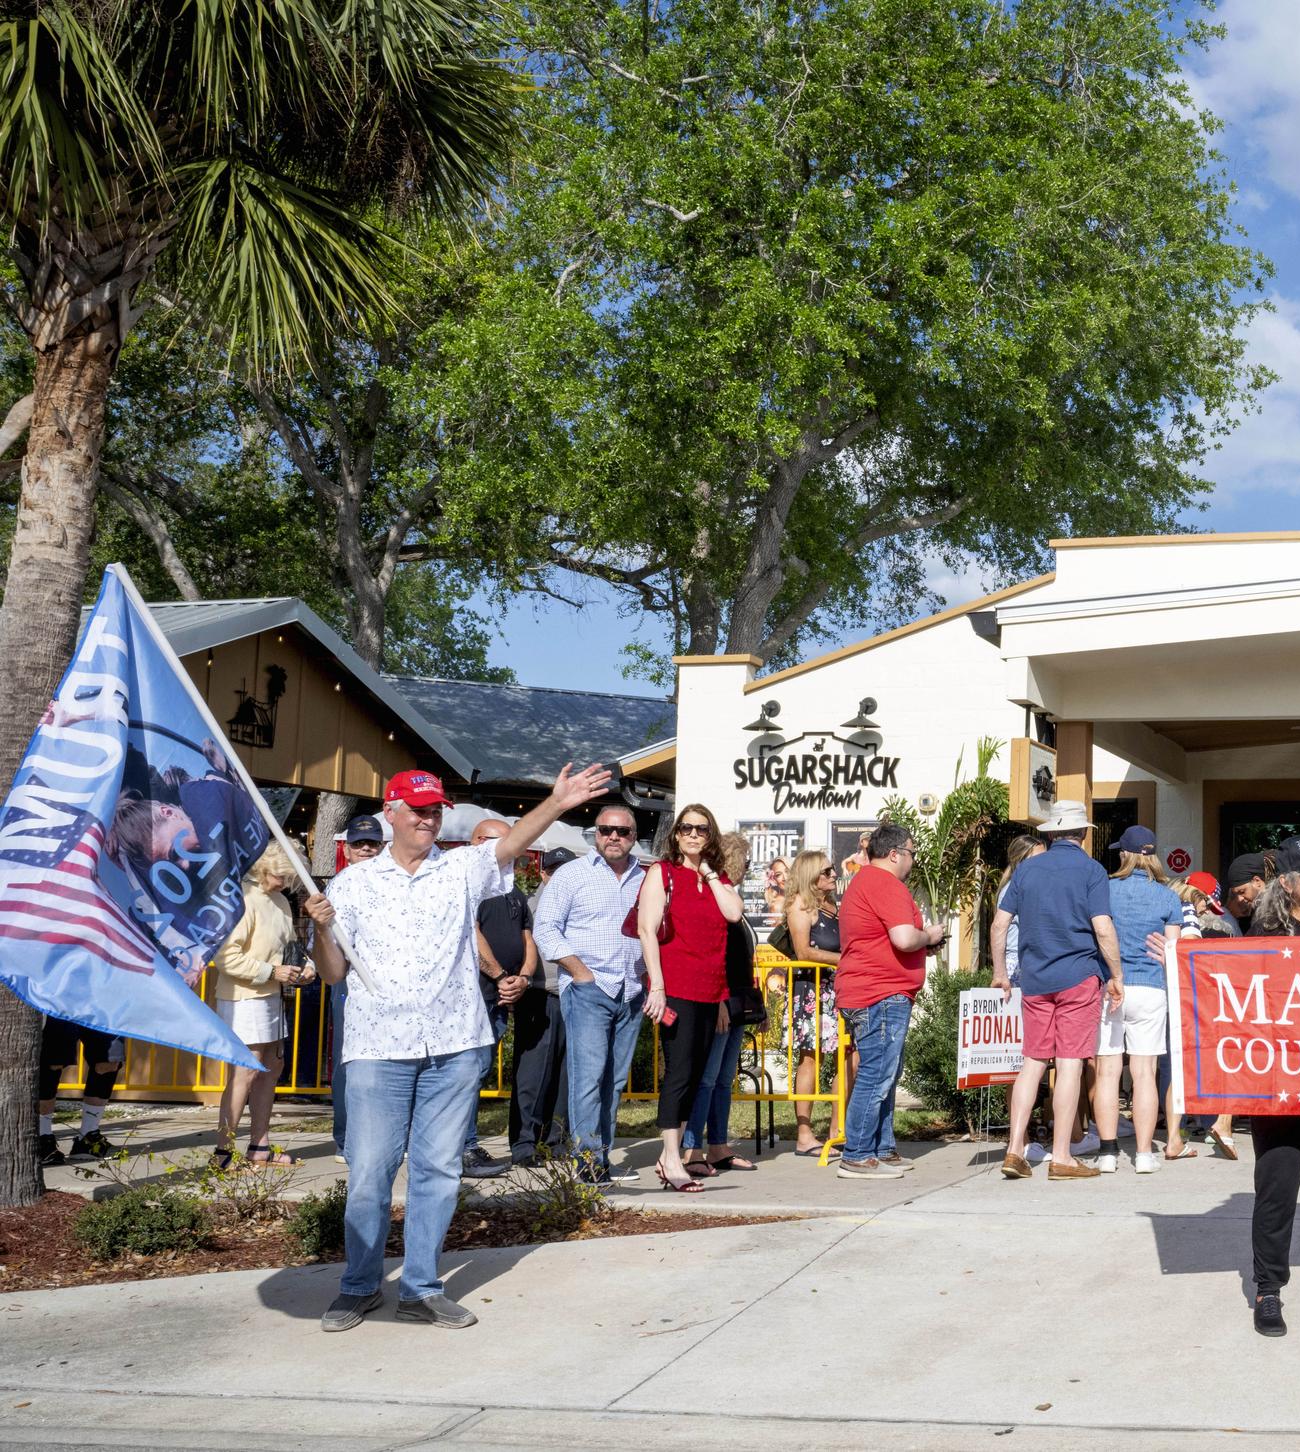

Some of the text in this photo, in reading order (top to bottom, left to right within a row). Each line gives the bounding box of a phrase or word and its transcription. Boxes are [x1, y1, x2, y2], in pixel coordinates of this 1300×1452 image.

[733, 754, 901, 789] SUGARSHACK
[773, 781, 861, 815] Downtown
[973, 1000, 998, 1013] BYRON
